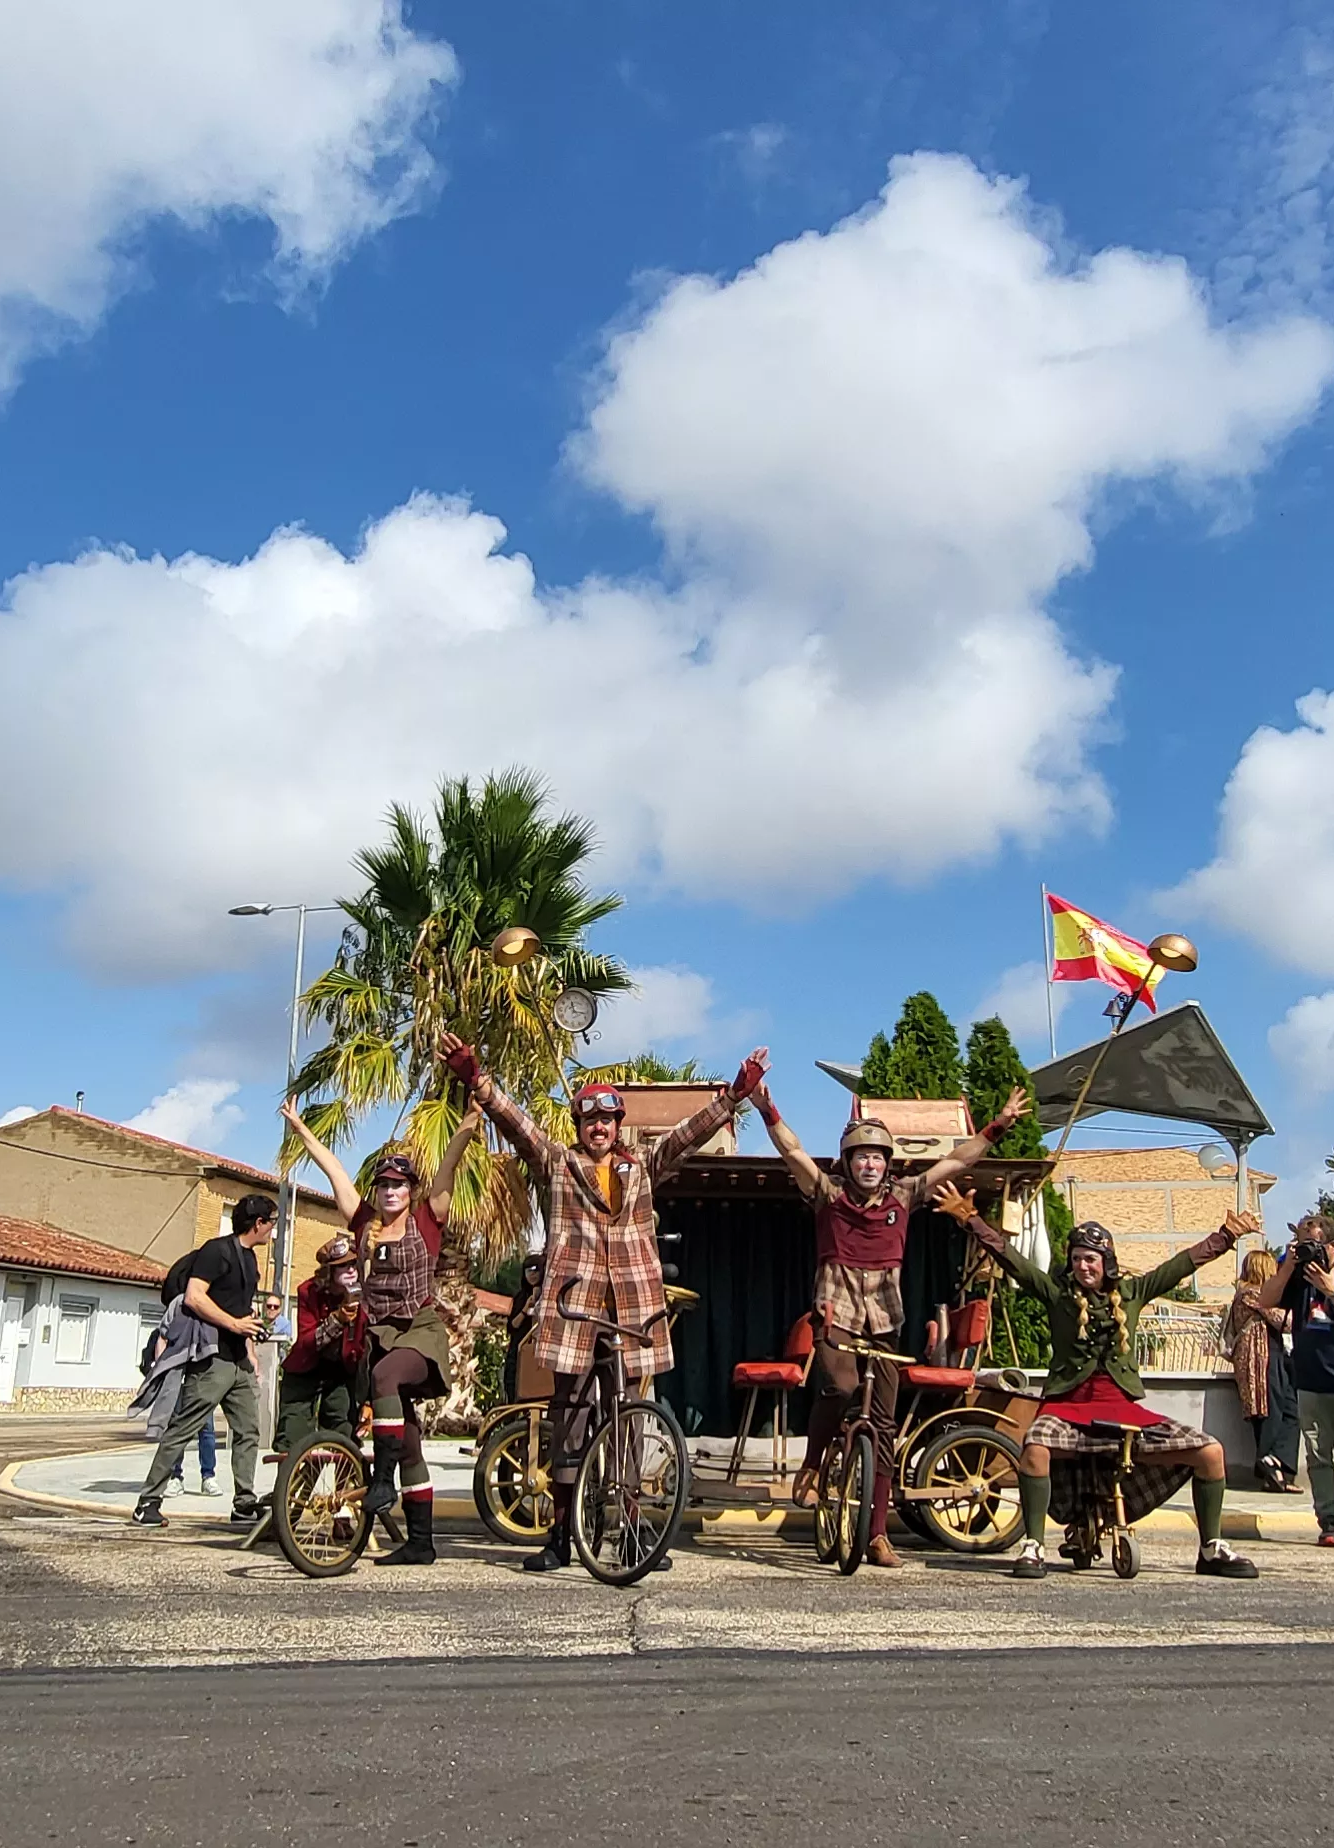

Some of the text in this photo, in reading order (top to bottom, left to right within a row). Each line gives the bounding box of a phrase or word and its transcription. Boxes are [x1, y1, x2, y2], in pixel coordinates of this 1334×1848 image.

[617, 1163, 629, 1173] 2
[887, 1211, 896, 1225] 3
[378, 1245, 387, 1260] 1
